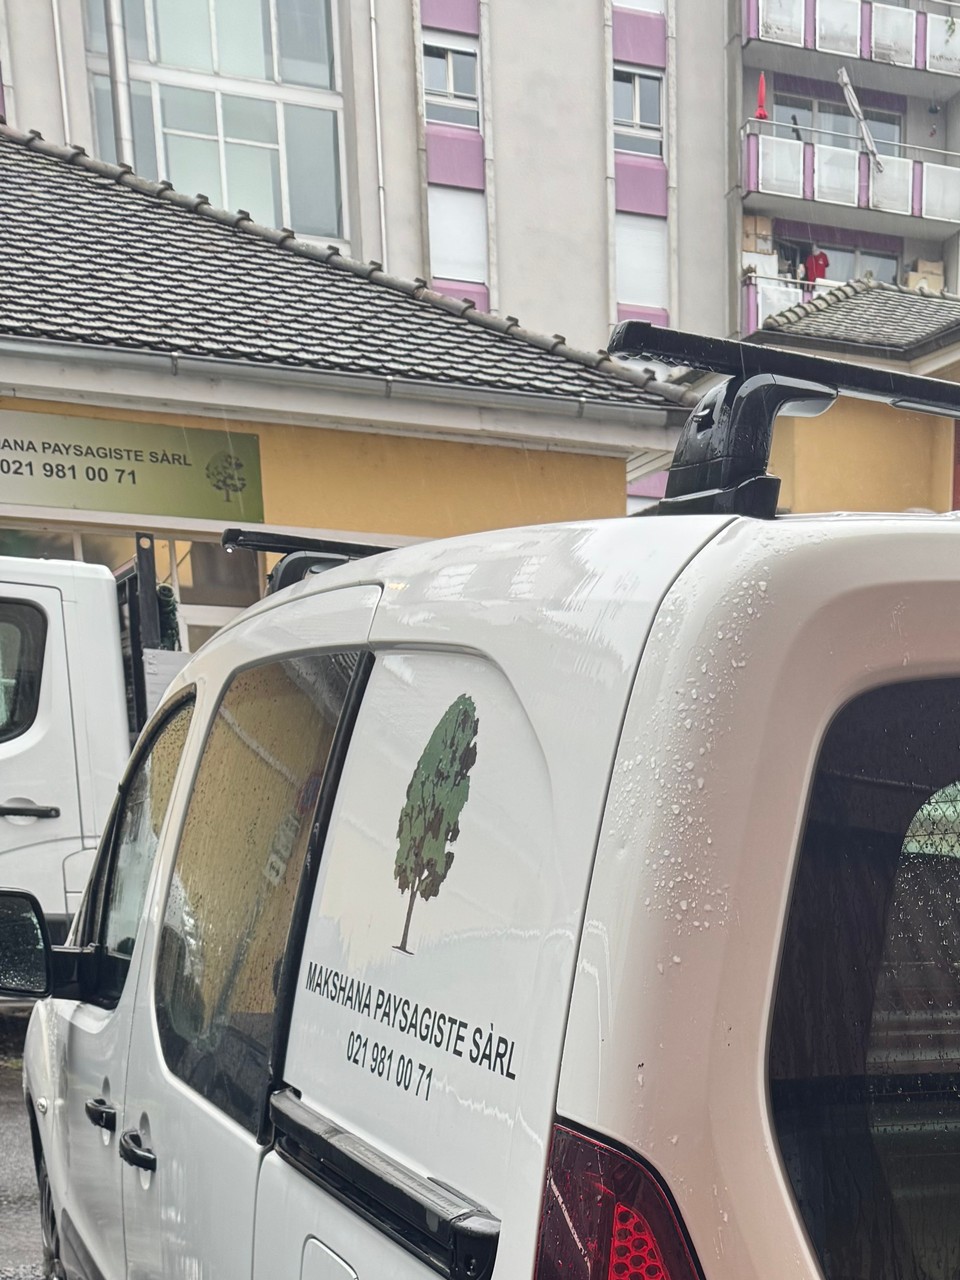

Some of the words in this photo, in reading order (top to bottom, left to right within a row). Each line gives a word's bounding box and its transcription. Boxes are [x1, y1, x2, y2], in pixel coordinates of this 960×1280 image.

[0, 438, 37, 454] ANA
[42, 441, 144, 463] PAYSAGISTE
[149, 450, 192, 467] SÀRL
[0, 458, 34, 476] 021
[42, 462, 77, 480] 981
[85, 466, 109, 482] 00
[115, 468, 137, 485] 71
[305, 961, 372, 1018] MAKSHANA
[373, 989, 468, 1058] PAYSAGISTE
[469, 1023, 516, 1081] SÀRL
[346, 1031, 369, 1069] 021
[370, 1042, 394, 1081] 981
[396, 1054, 413, 1091] 00
[415, 1063, 433, 1101] 71
